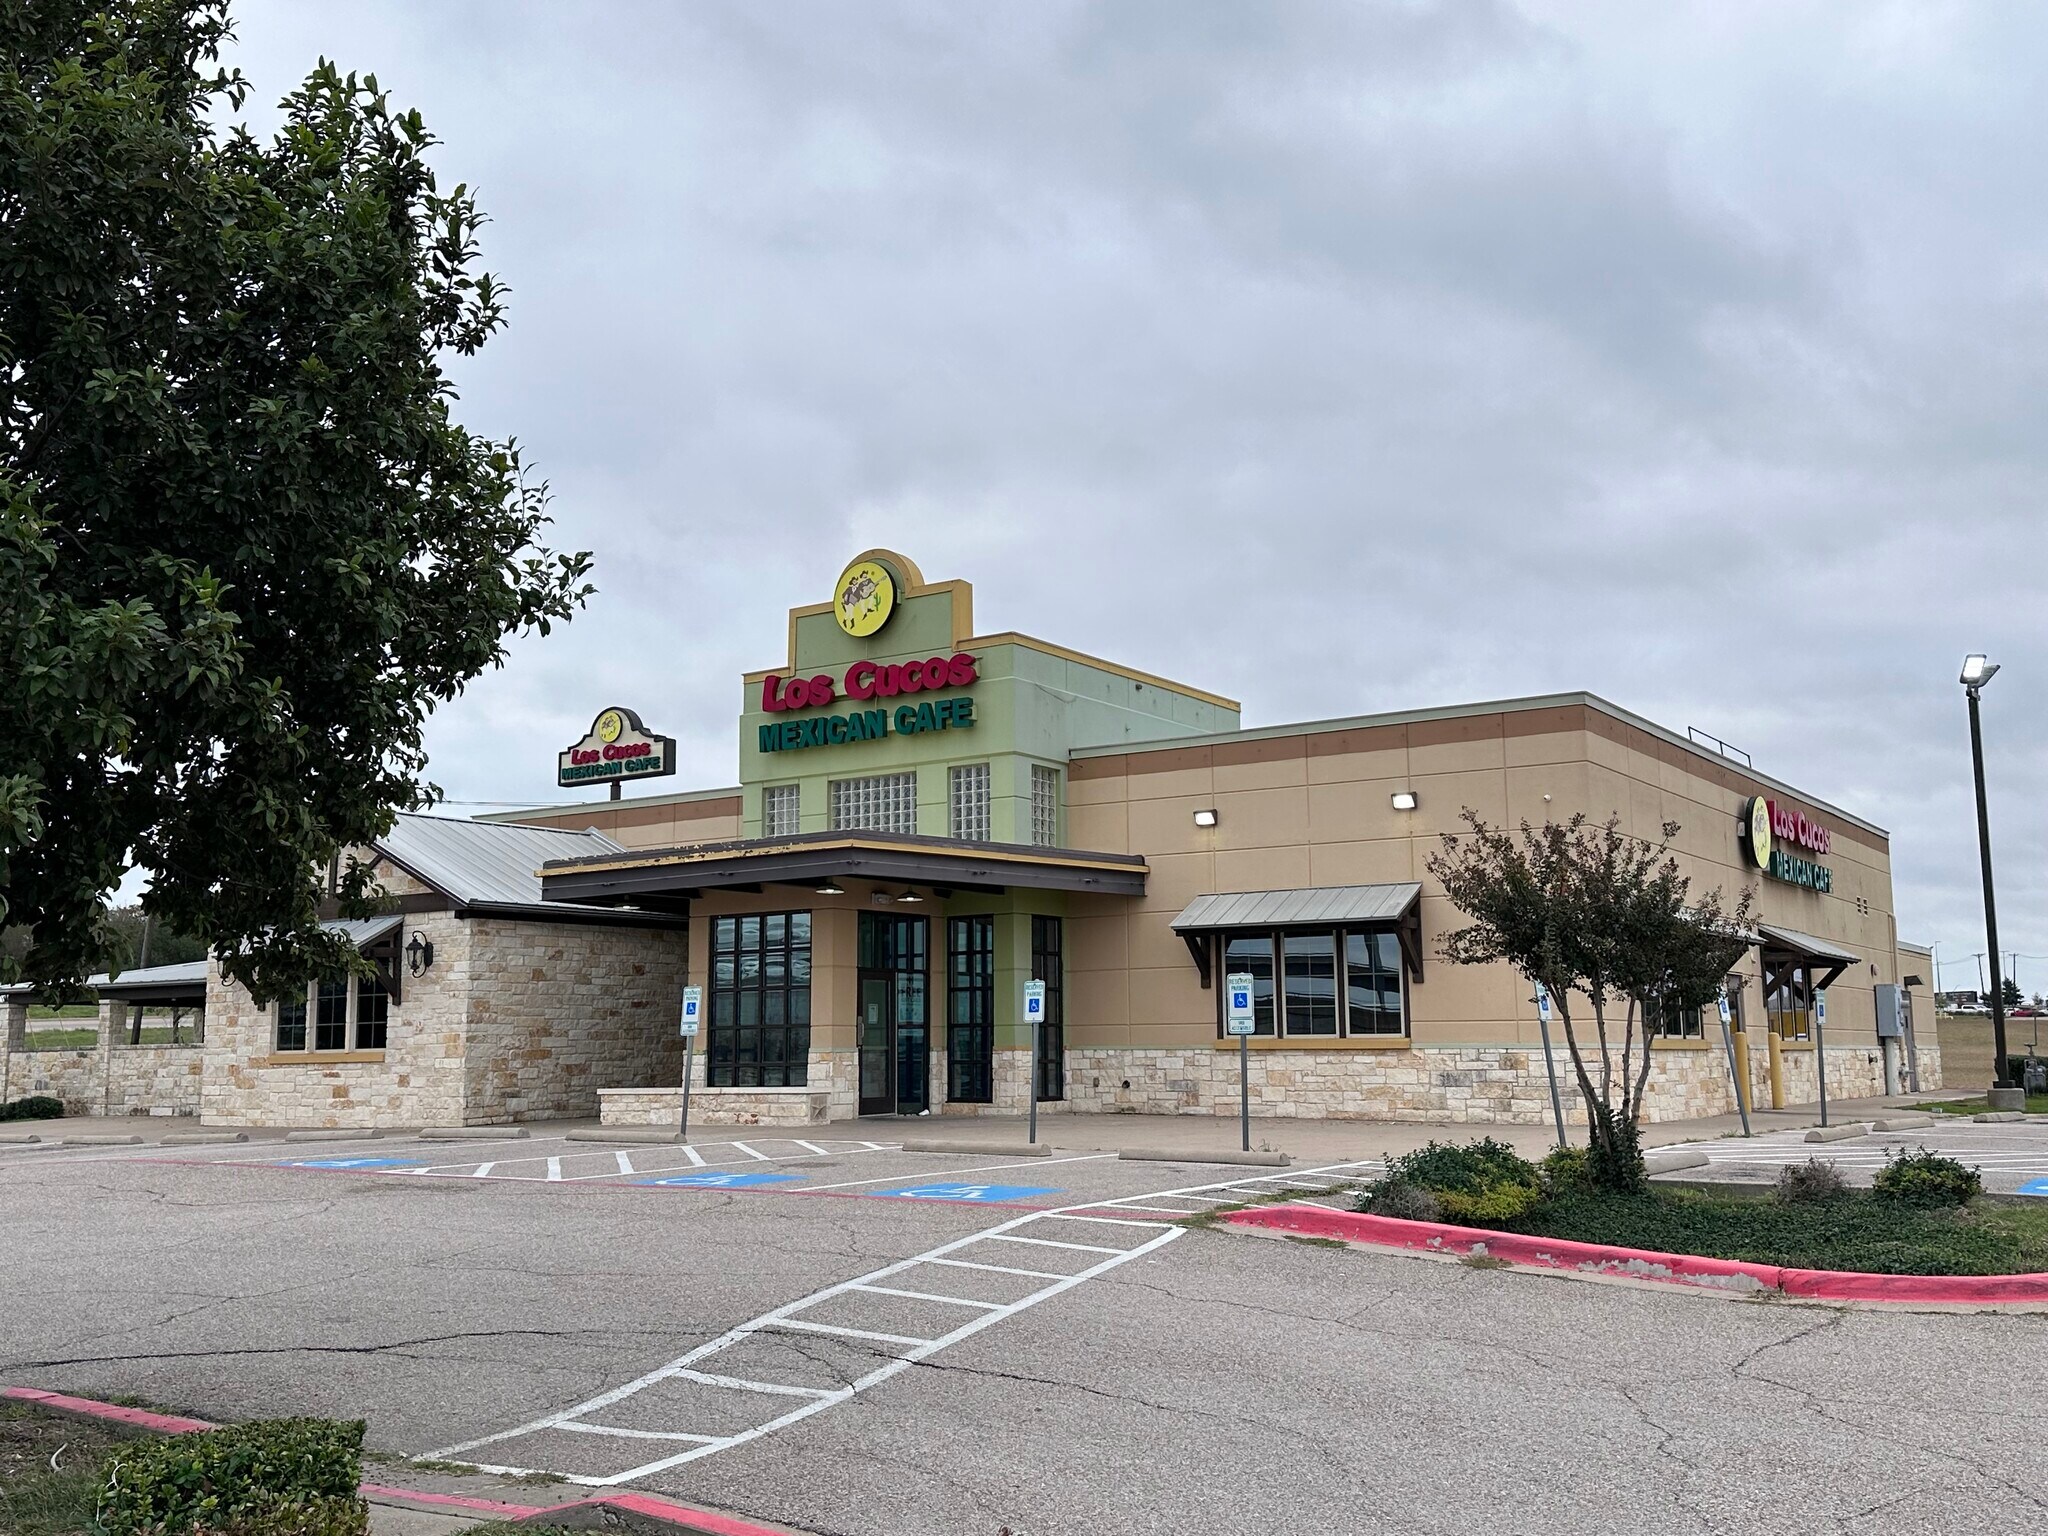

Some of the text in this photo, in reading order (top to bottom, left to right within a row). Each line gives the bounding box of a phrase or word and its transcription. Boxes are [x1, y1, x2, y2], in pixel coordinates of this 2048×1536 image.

[759, 697, 974, 752] MEXICAN CAFE
[561, 756, 661, 780] MEXICAN CAFE
[1771, 850, 1833, 894] MEXICAN CAFE
